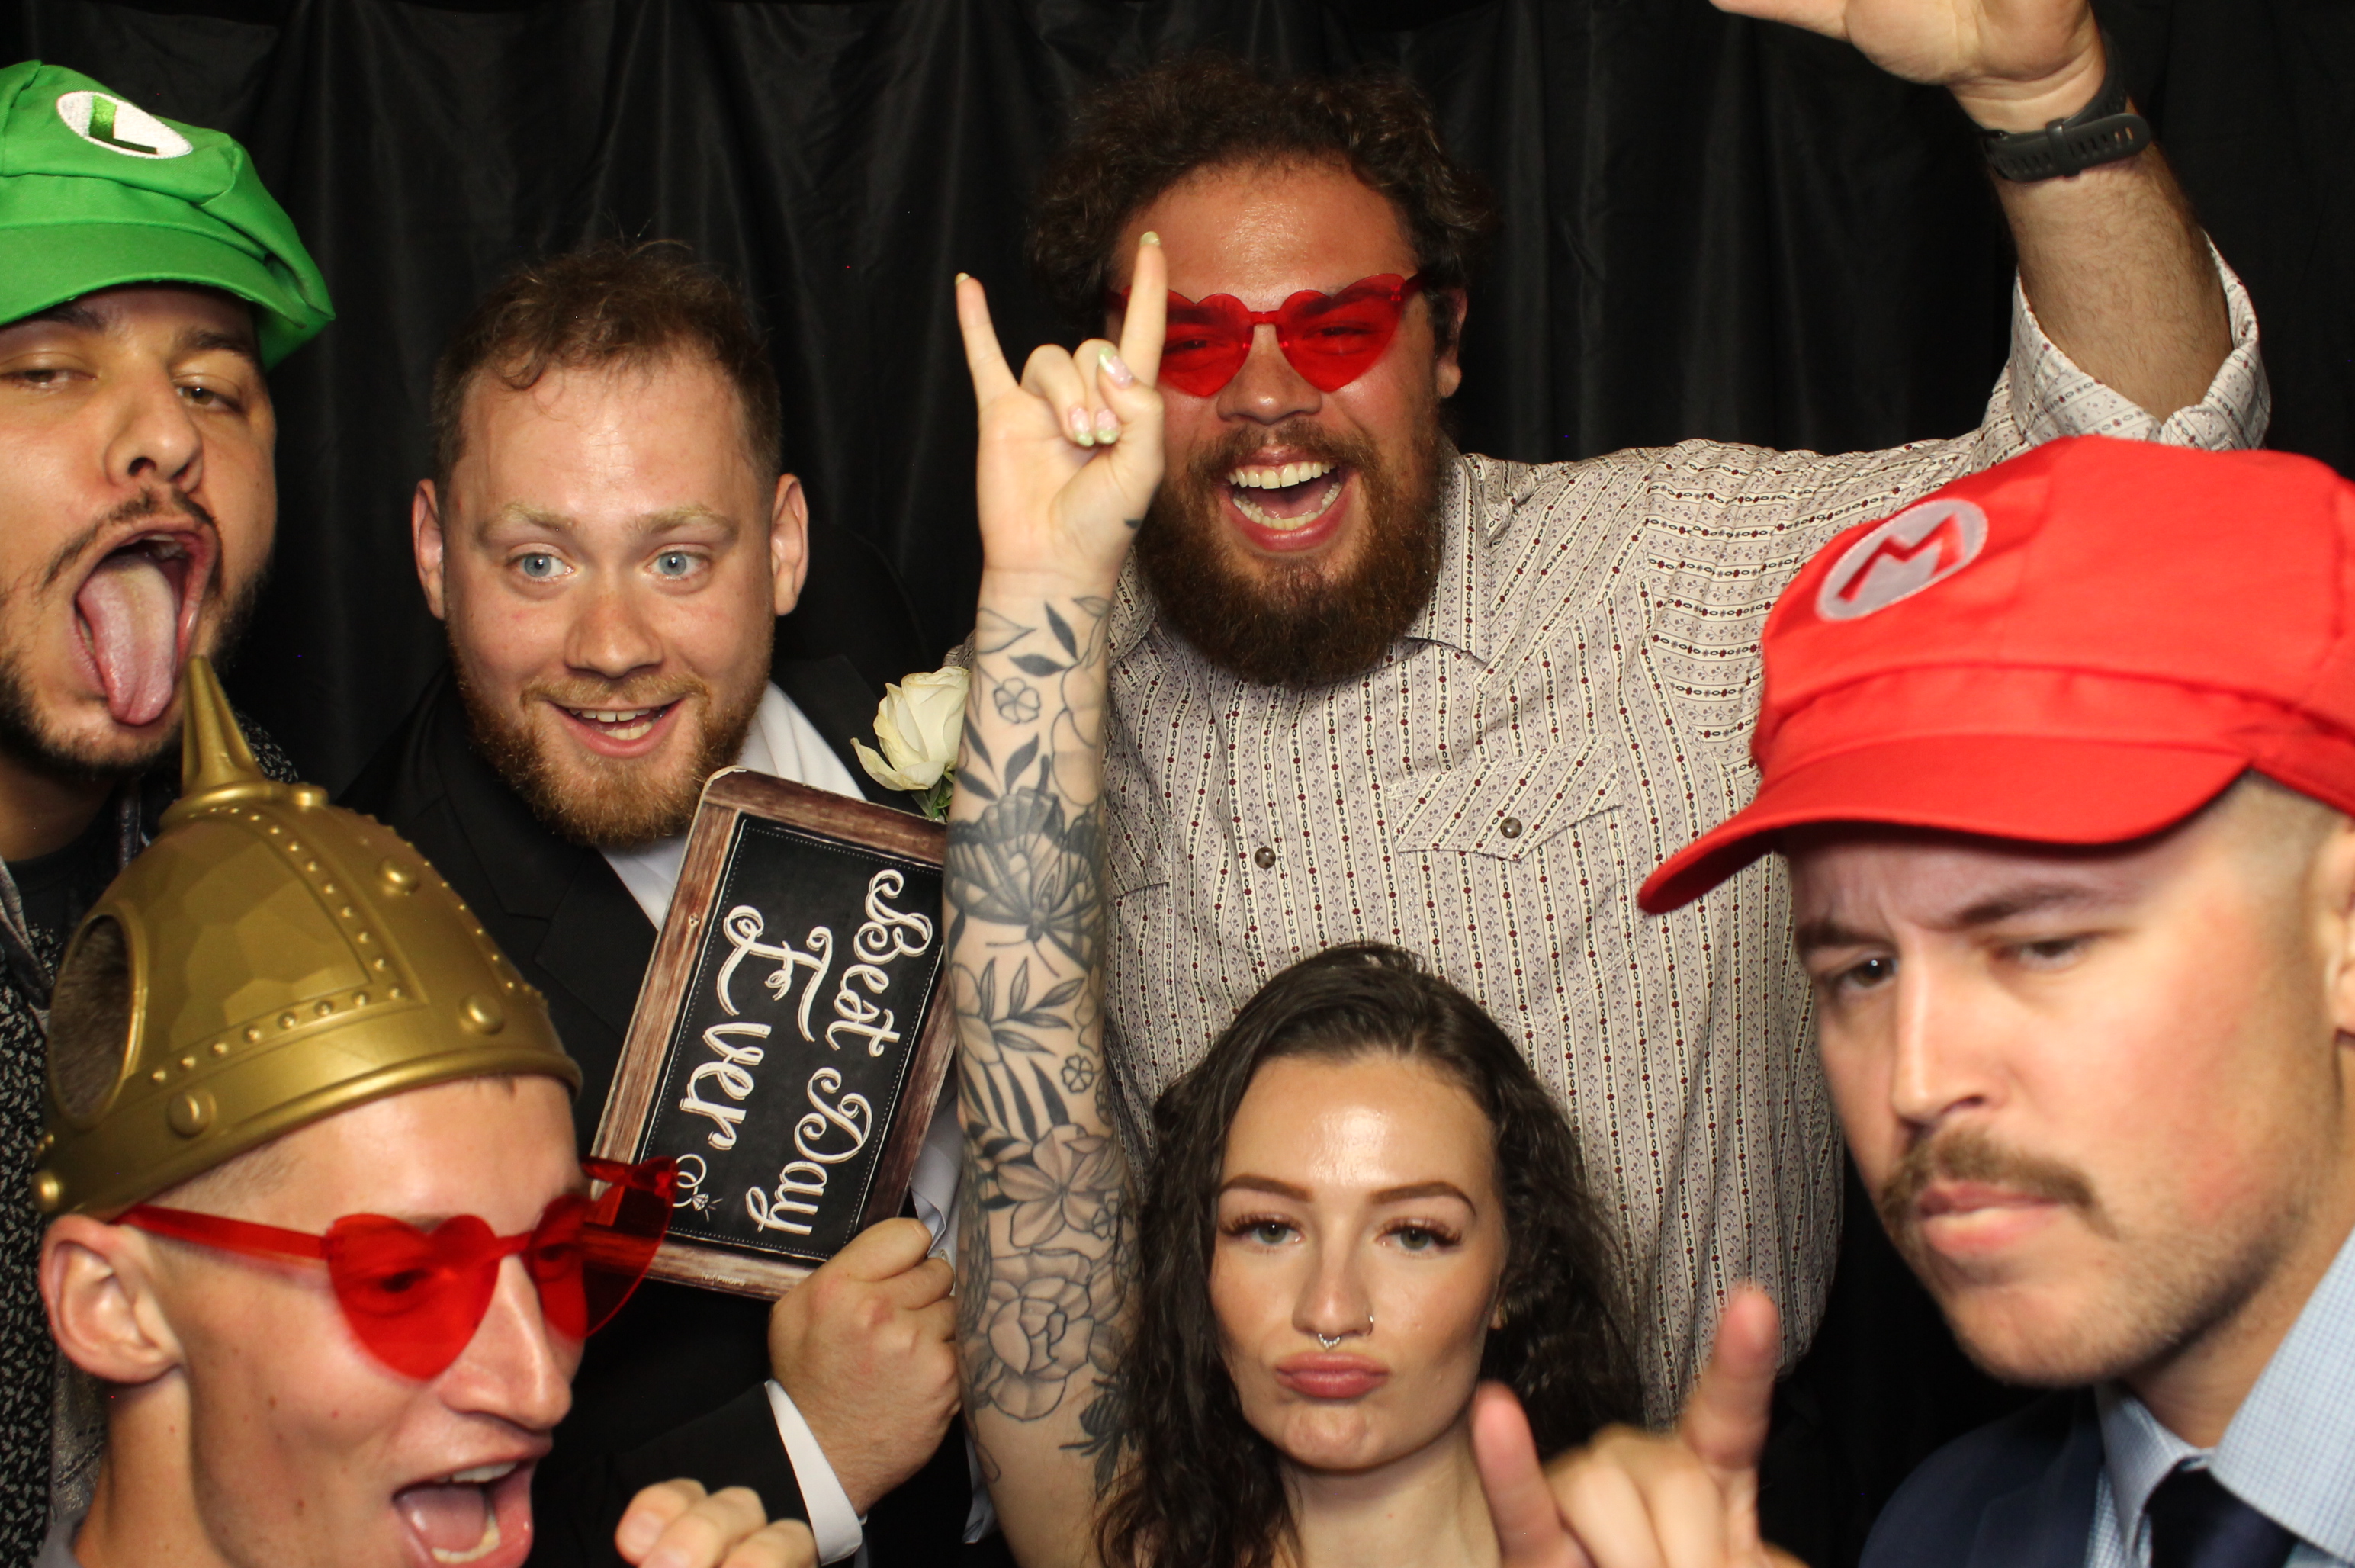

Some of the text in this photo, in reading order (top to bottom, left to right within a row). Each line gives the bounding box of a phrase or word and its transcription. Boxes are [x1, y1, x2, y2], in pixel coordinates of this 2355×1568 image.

[88, 95, 157, 155] L
[1834, 513, 1965, 602] M
[680, 905, 834, 1150] Ever
[747, 869, 932, 1236] Best Day
